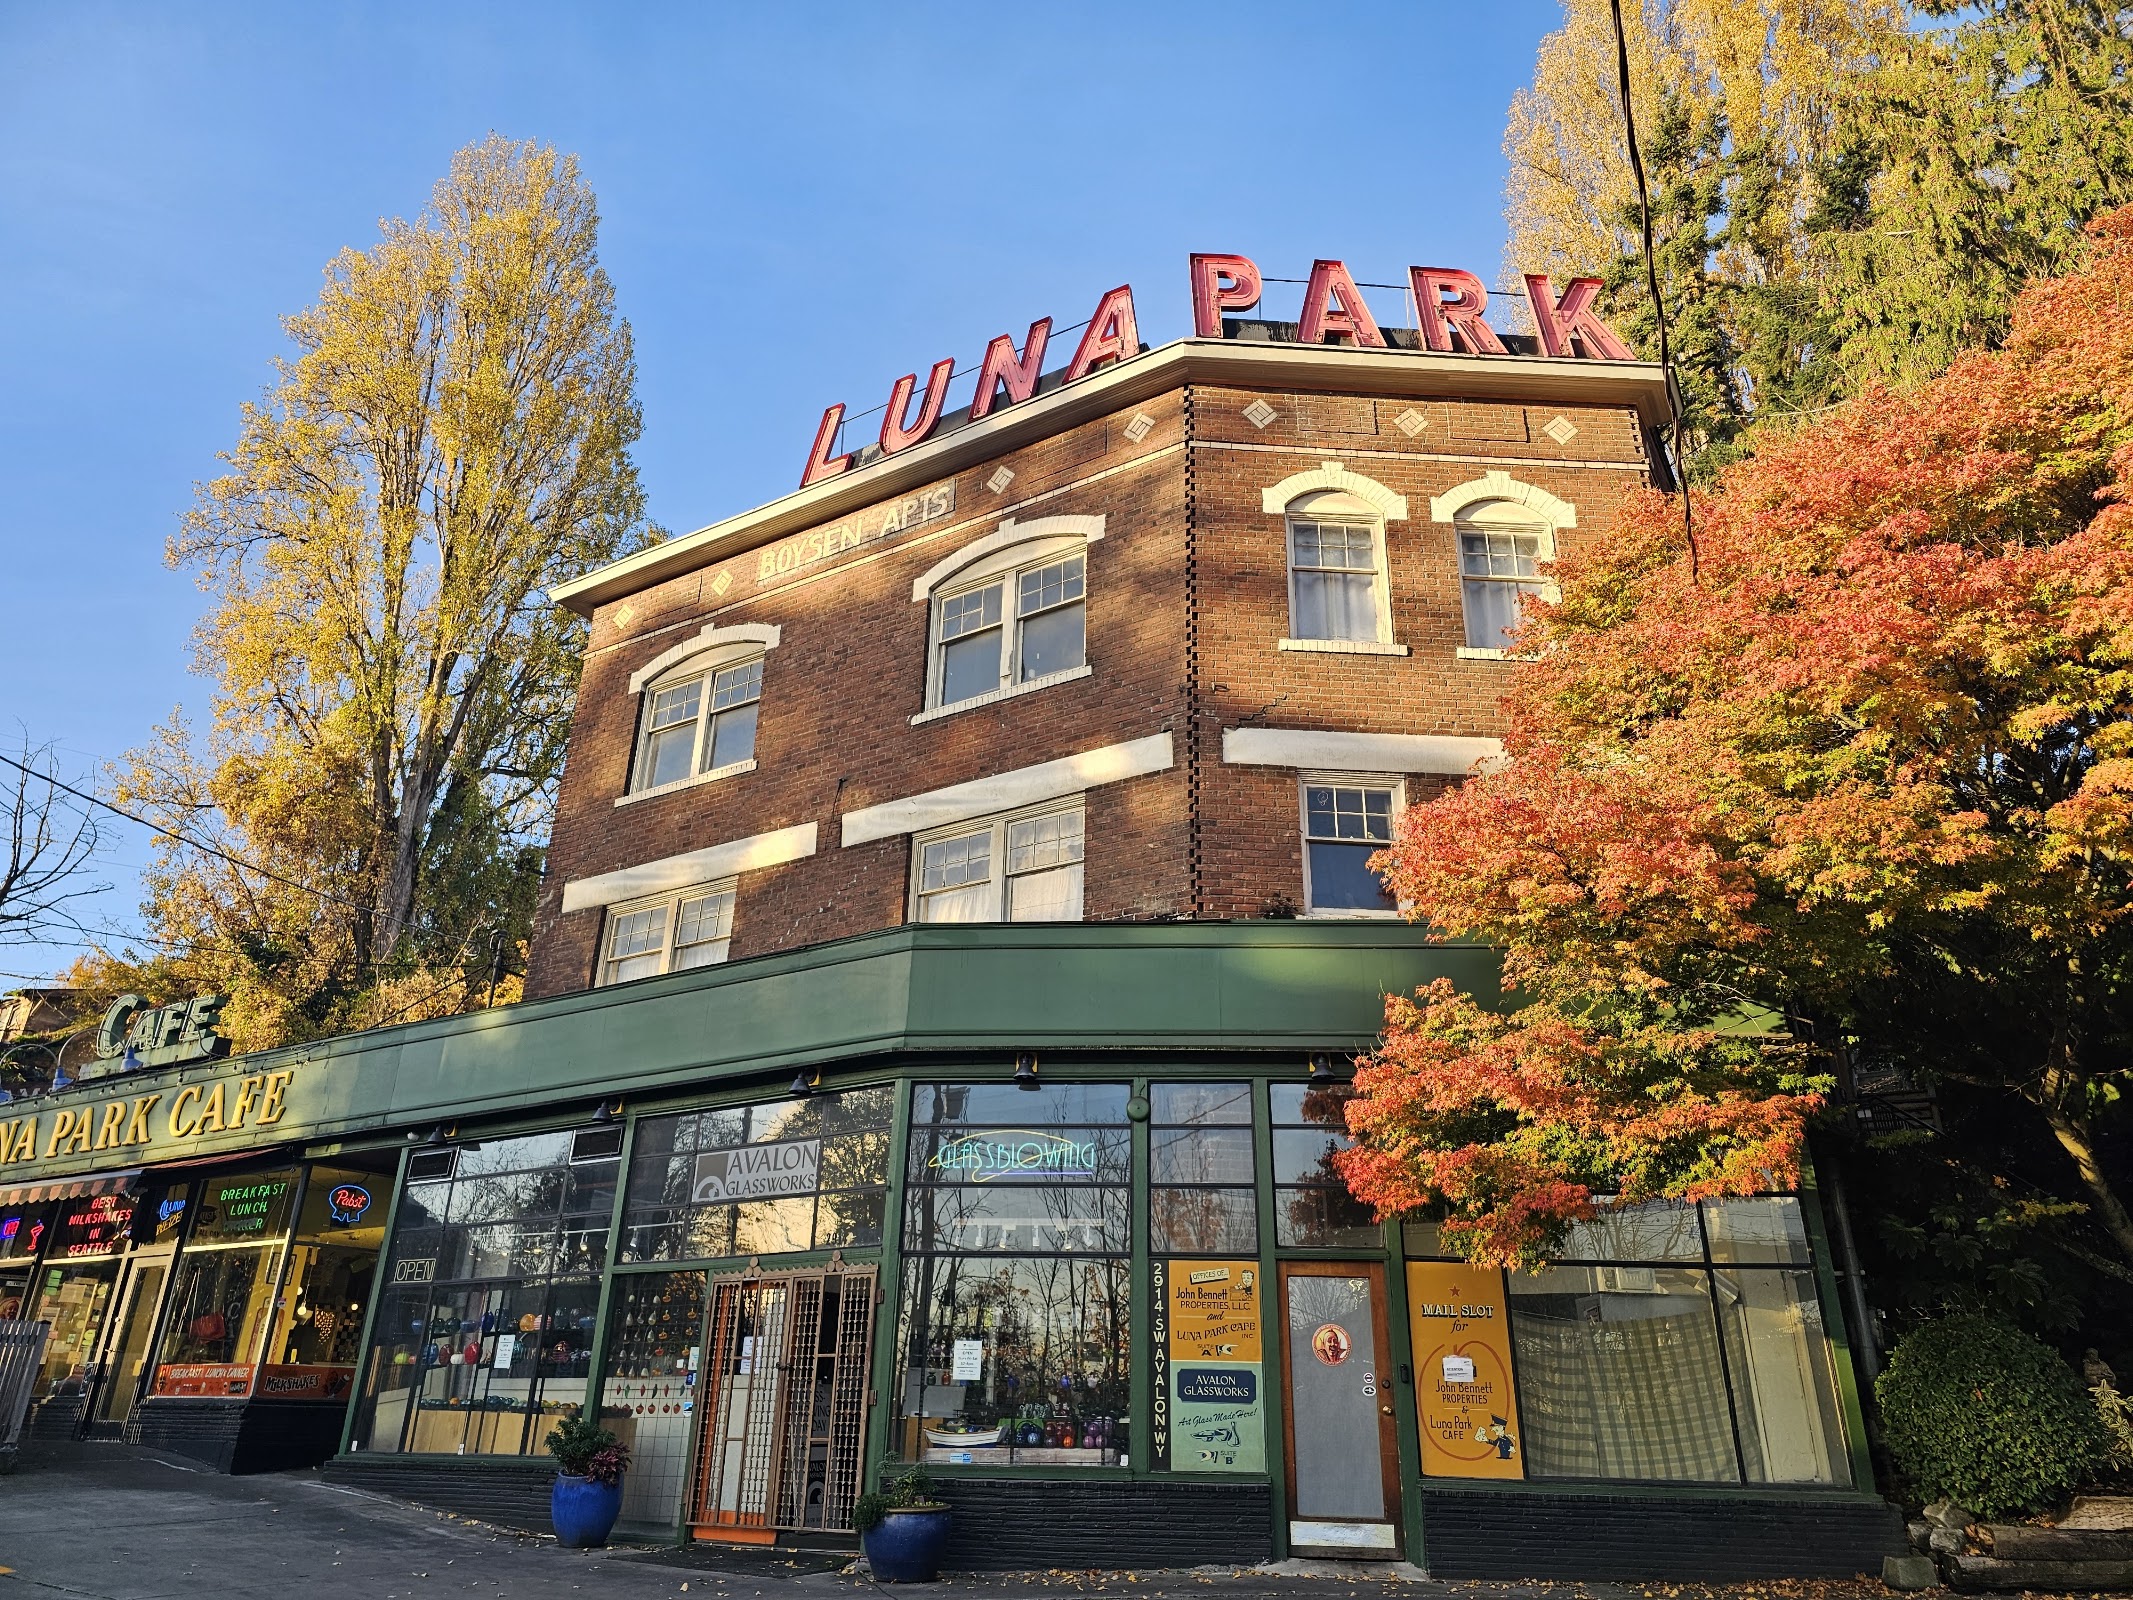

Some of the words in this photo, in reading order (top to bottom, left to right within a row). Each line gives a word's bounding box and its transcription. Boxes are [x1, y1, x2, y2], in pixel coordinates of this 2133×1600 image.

[799, 283, 1140, 490] LUNA
[1189, 252, 1638, 361] PARK
[759, 518, 863, 582] BOYSEN
[879, 486, 951, 538] APTS
[97, 993, 229, 1060] CAFE
[0, 1116, 38, 1165] NA
[44, 1094, 162, 1159] PARK
[168, 1070, 294, 1138] CAFE
[727, 1143, 818, 1176] AVALON
[938, 1142, 1095, 1170] GLASSBLOWING
[220, 1182, 287, 1201] BREAKFAST
[725, 1173, 816, 1196] GLASSWORKS
[91, 1196, 118, 1210] BEST
[336, 1189, 367, 1209] Pabst
[230, 1200, 269, 1216] LUNCH
[68, 1209, 133, 1226] MILKSHAKES
[89, 1228, 102, 1239] IN
[67, 1241, 114, 1257] SEATTLE
[396, 1260, 436, 1281] OPEN
[1192, 1270, 1216, 1280] OFFICES
[1176, 1287, 1195, 1299] John
[1198, 1287, 1228, 1300] Bennett
[1206, 1311, 1224, 1321] and
[1421, 1303, 1458, 1317] MAIL
[1461, 1304, 1494, 1318] SLOT
[1177, 1330, 1202, 1341] LUNA
[1204, 1324, 1228, 1339] PARK
[1230, 1322, 1256, 1332] CAFE
[1450, 1320, 1469, 1334] for
[264, 1374, 321, 1393] MILKSHAKES
[1196, 1375, 1236, 1385] AVALON
[1435, 1379, 1456, 1393] John
[1458, 1381, 1493, 1394] Bennett
[1184, 1386, 1249, 1397] GLASSWORKS
[1442, 1394, 1488, 1404] PROPERTIES
[1178, 1417, 1191, 1427] Art
[1192, 1415, 1212, 1428] Glass
[1213, 1411, 1235, 1422] Made
[1235, 1407, 1258, 1419] Here!
[1461, 1405, 1470, 1415] &
[1430, 1415, 1453, 1429] Luna
[1454, 1415, 1473, 1430] Park
[1442, 1429, 1464, 1440] CAFE
